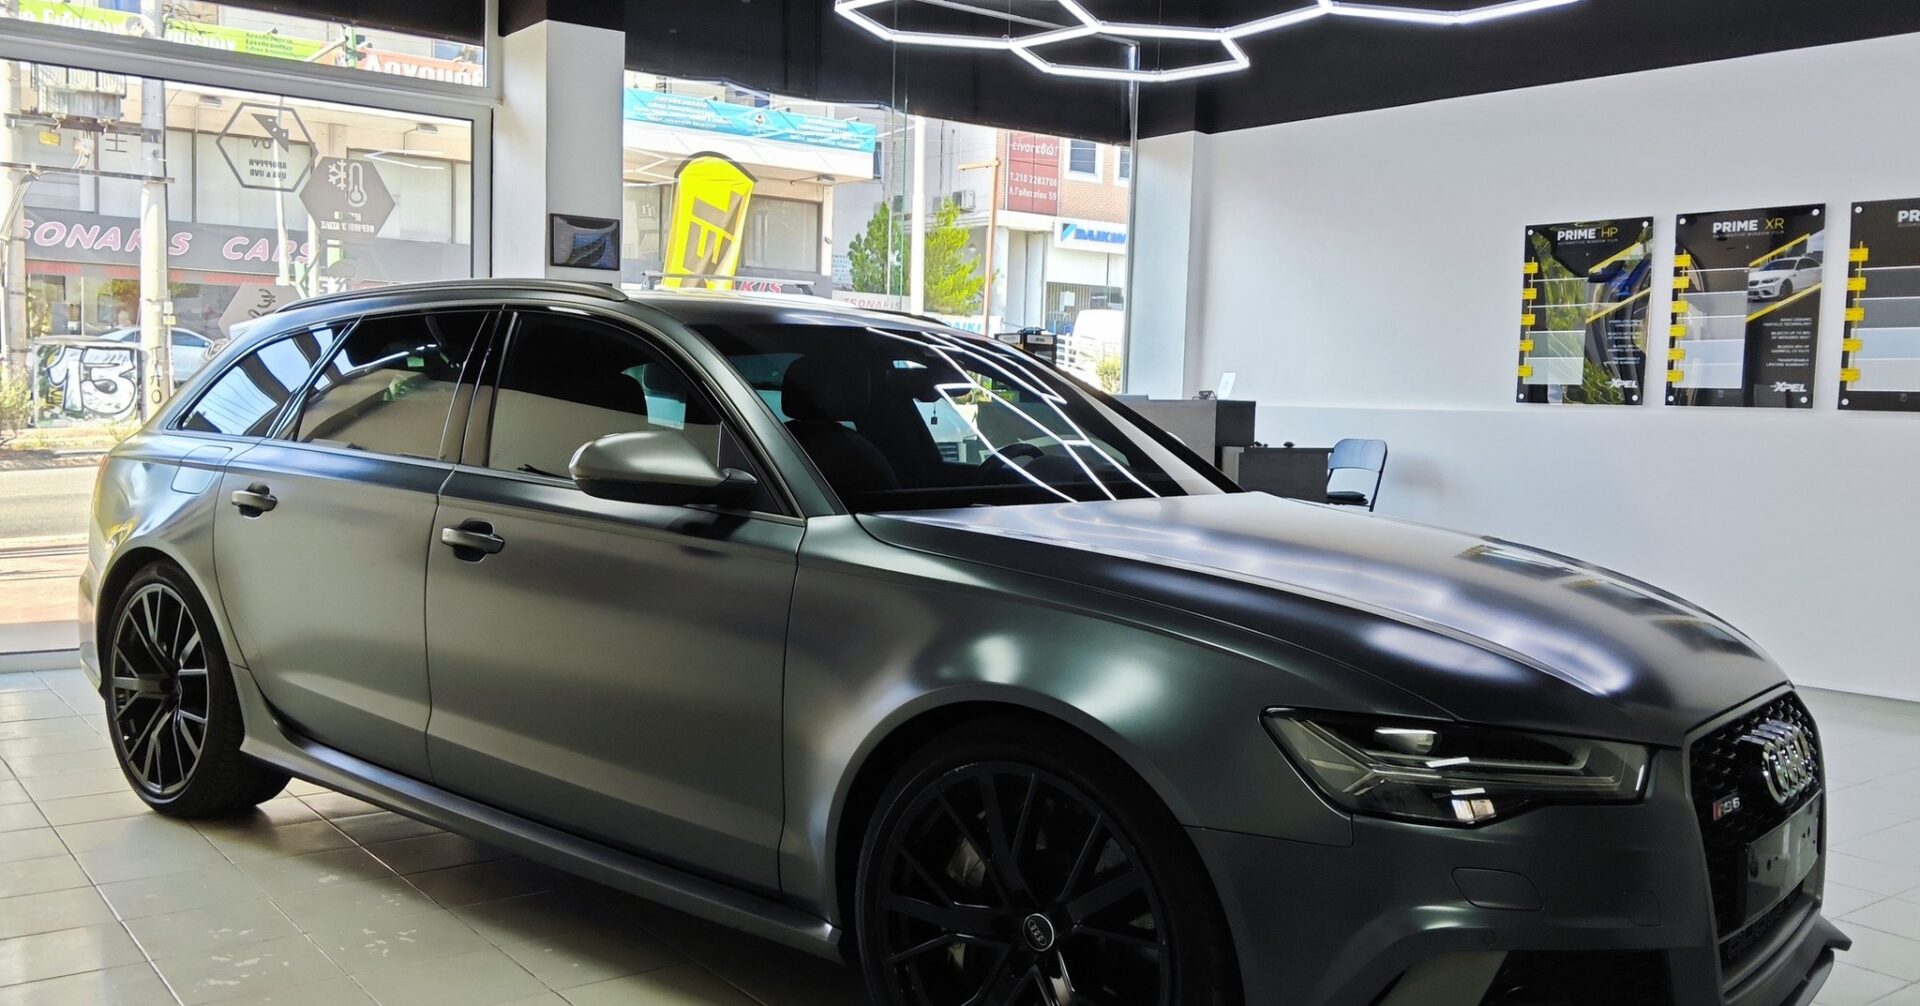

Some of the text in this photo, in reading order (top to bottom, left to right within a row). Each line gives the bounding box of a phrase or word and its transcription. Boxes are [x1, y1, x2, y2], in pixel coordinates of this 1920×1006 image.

[1712, 217, 1784, 233] PRIME XR
[1557, 227, 1618, 241] PRIME HP
[1773, 381, 1807, 392] XPEL
